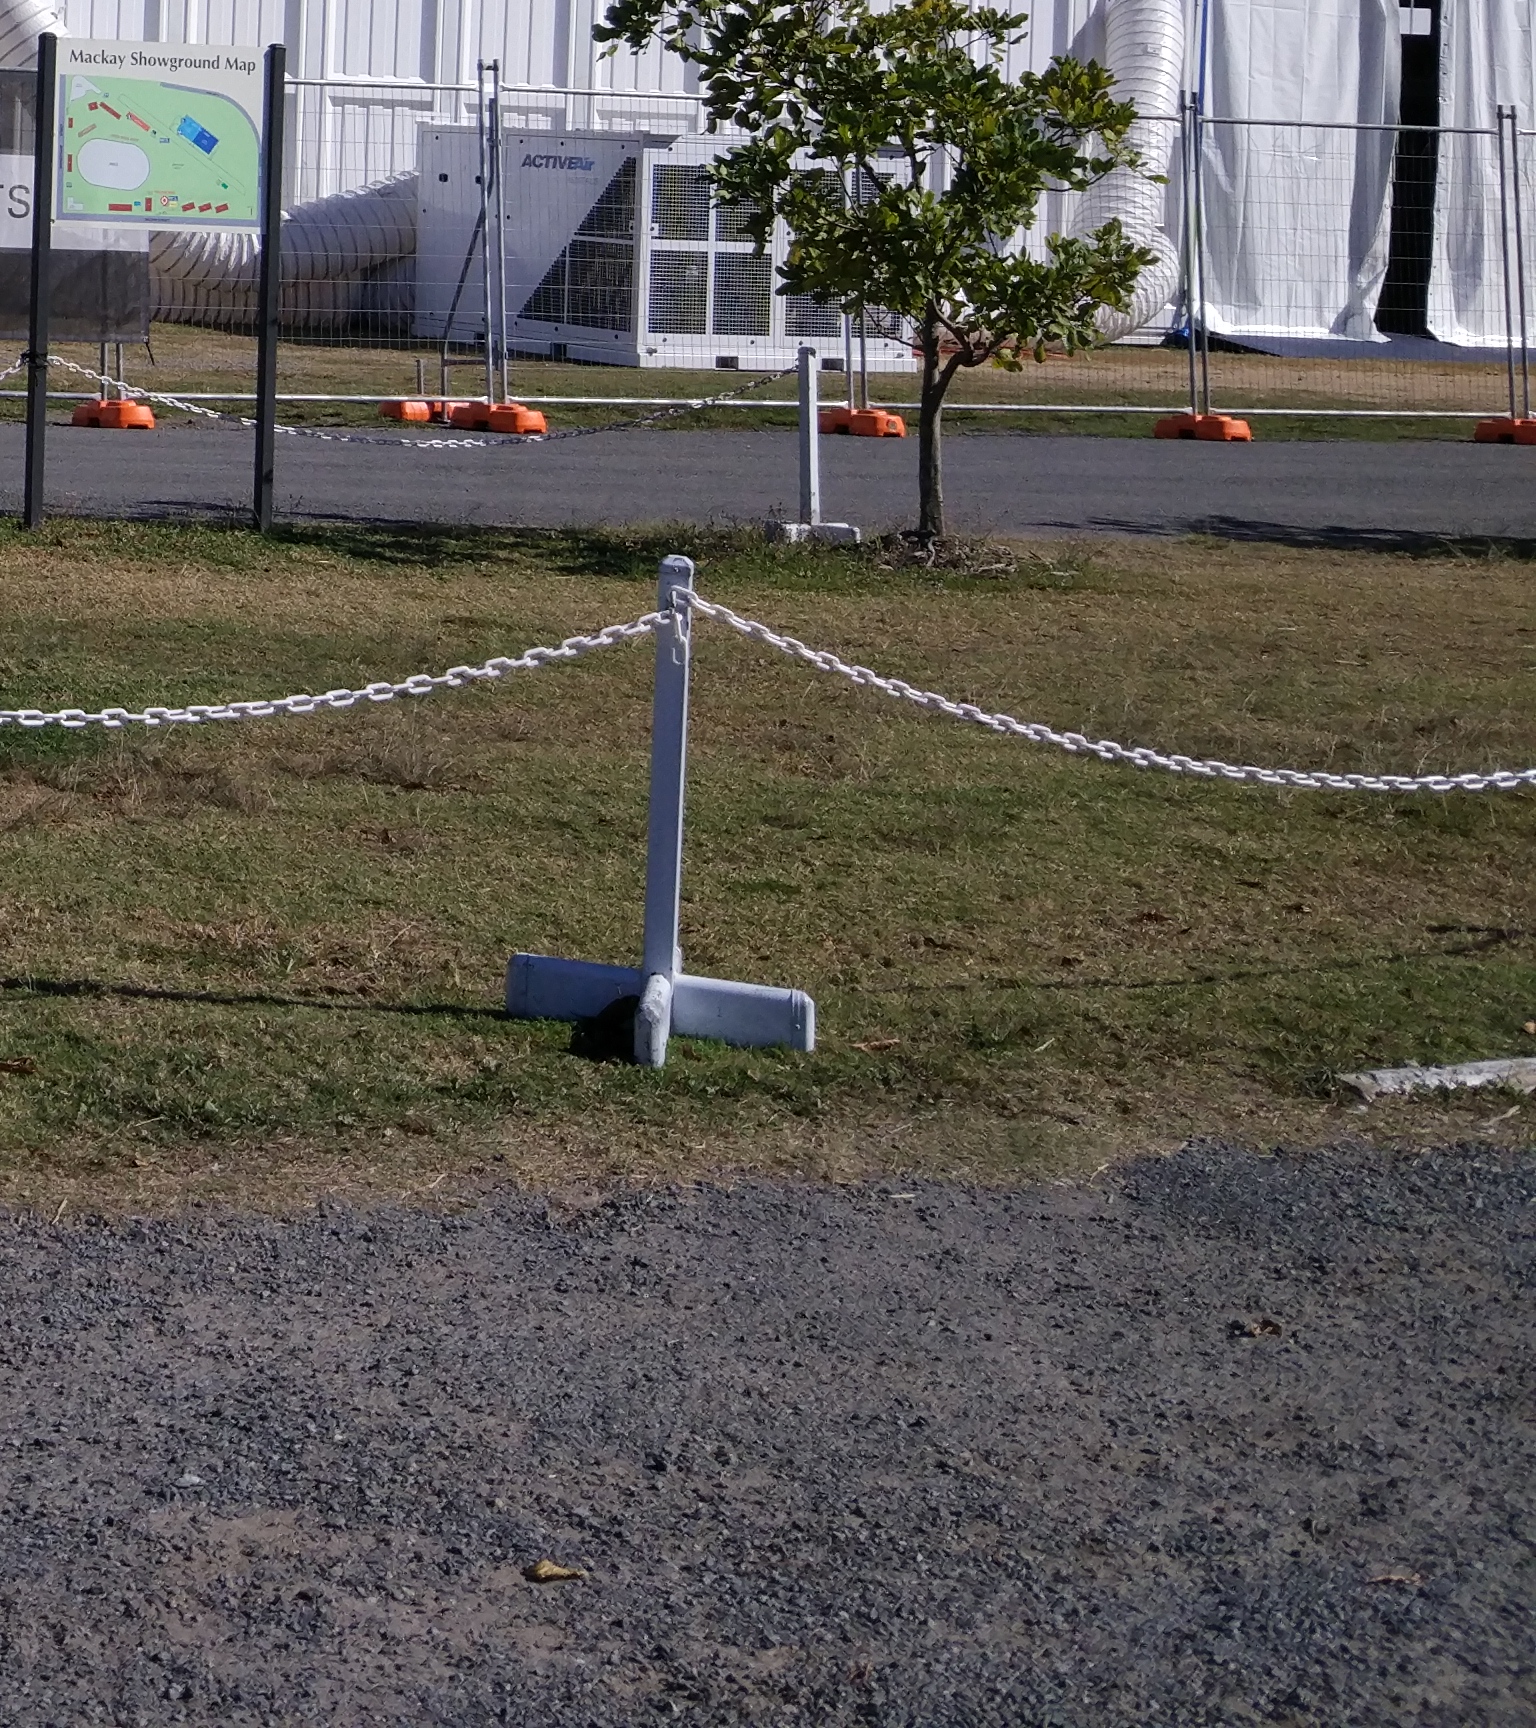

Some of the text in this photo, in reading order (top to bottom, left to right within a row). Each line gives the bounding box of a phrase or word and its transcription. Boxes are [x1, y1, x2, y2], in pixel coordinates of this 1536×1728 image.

[69, 49, 257, 75] Mackay Showground Map
